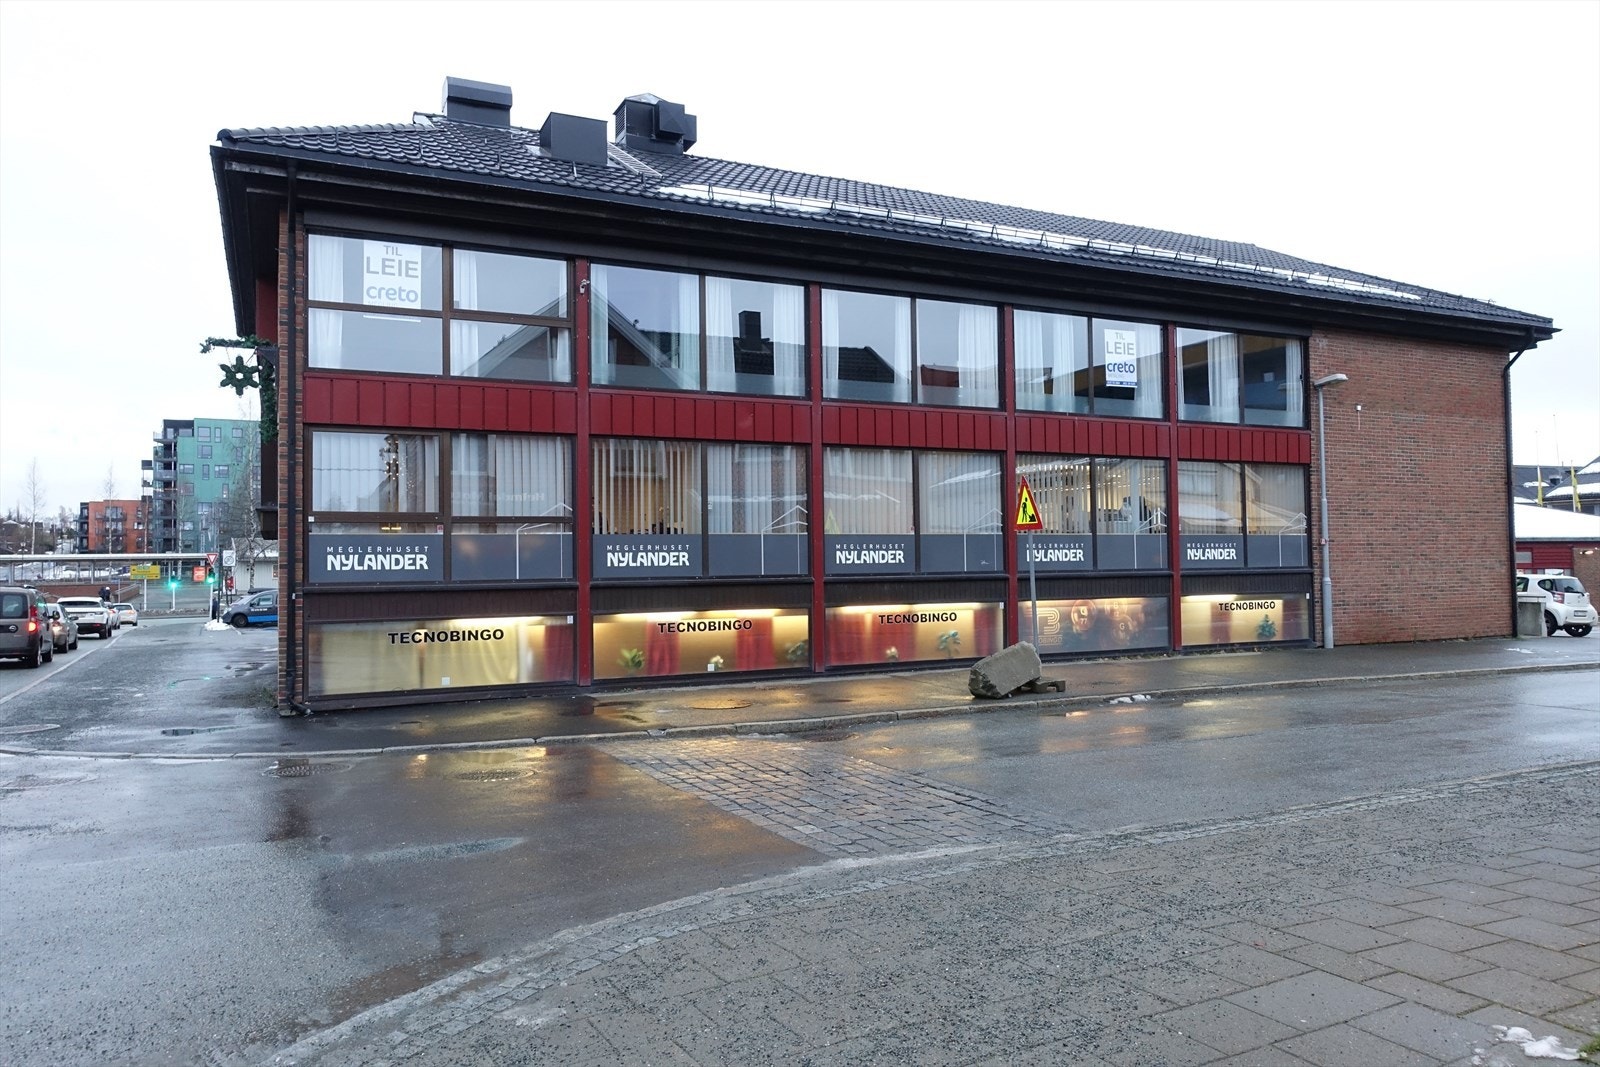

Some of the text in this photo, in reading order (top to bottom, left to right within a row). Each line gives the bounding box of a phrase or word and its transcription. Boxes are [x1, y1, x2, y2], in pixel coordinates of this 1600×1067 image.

[383, 245, 403, 257] TIL
[366, 256, 419, 278] LEIE
[366, 286, 419, 303] creto
[1115, 332, 1126, 340] TIL
[1106, 341, 1135, 356] LEIE
[1106, 361, 1136, 374] creto
[606, 552, 690, 567] NYLANDER
[836, 551, 905, 564] NYLANDER
[1187, 548, 1237, 560] NYLANDER
[327, 554, 429, 571] NYLANDER
[1219, 601, 1276, 611] TECNOBINGO
[879, 612, 957, 624] TECNOBINGO
[657, 619, 753, 633] TECNOBINGO
[388, 629, 504, 644] TECNOBINGO
